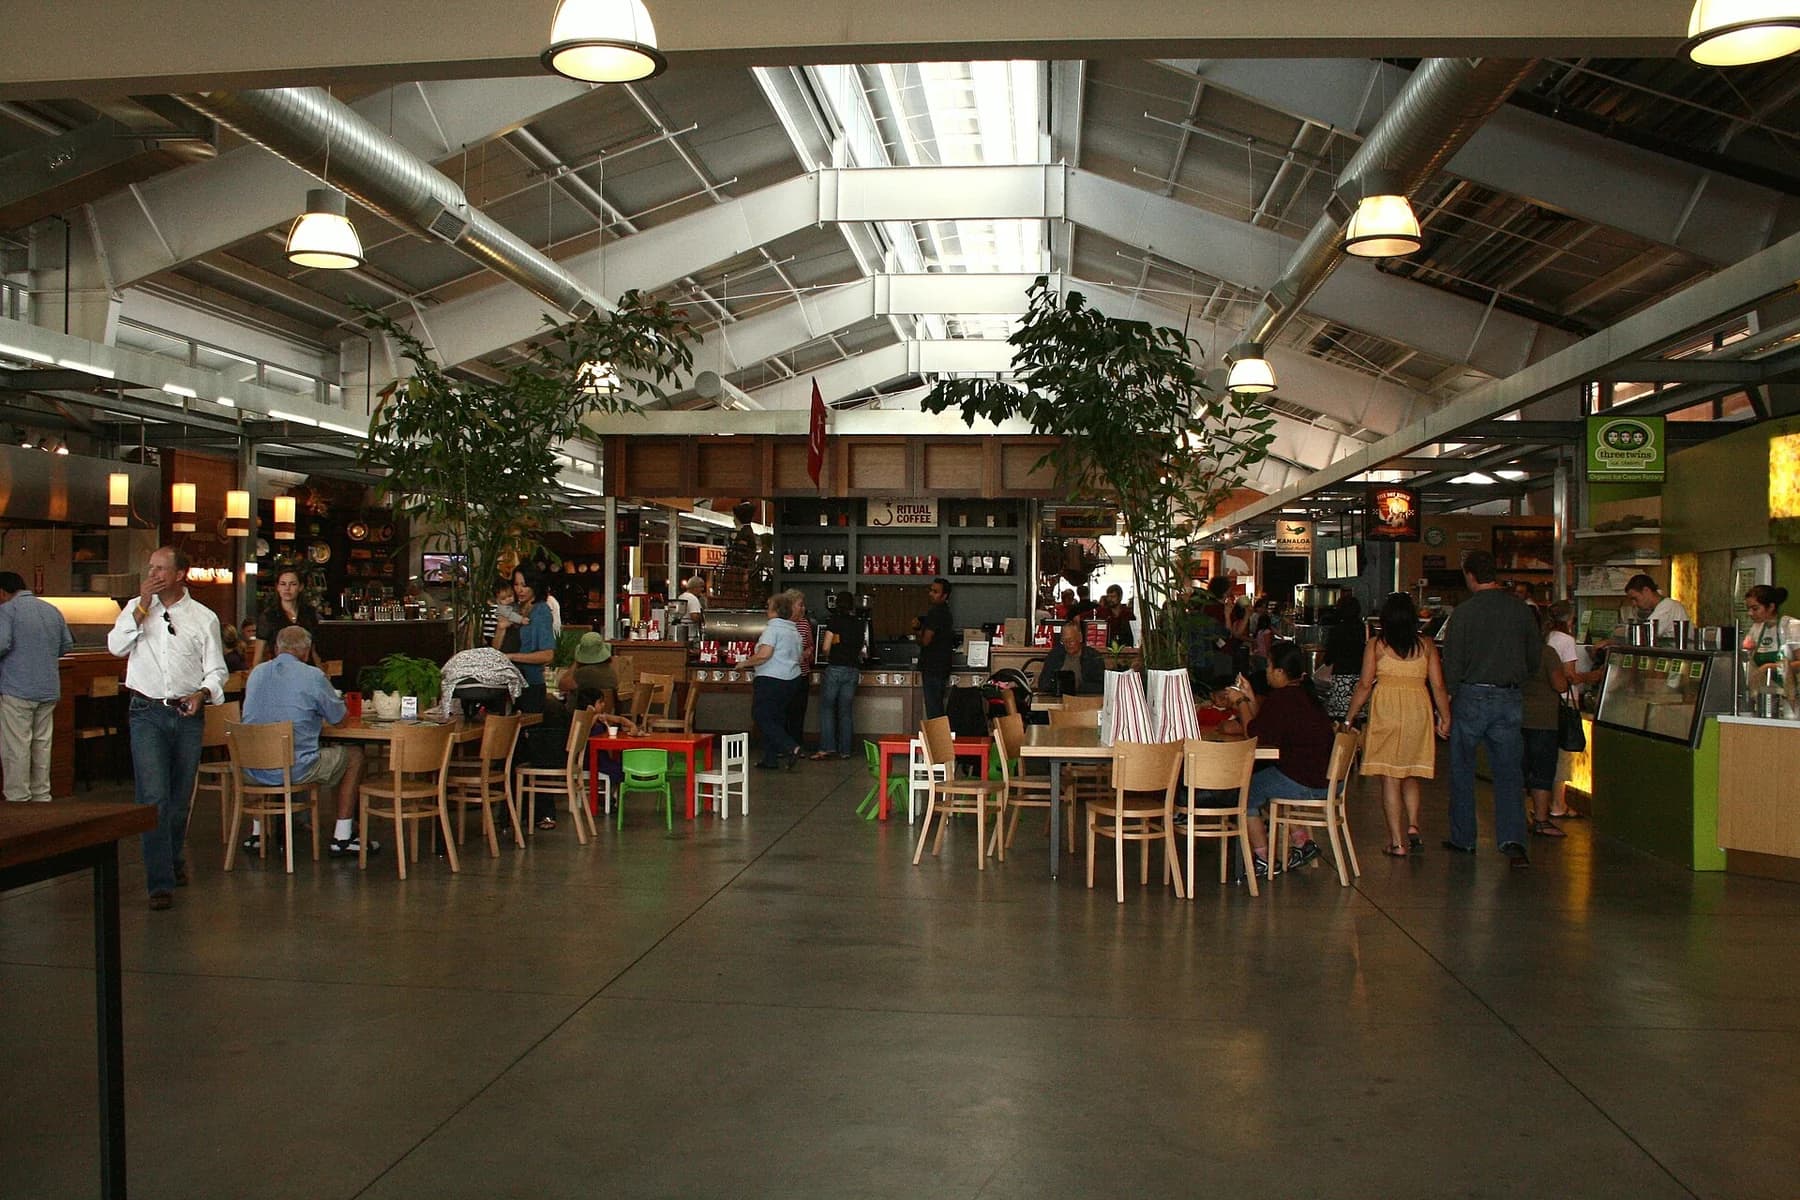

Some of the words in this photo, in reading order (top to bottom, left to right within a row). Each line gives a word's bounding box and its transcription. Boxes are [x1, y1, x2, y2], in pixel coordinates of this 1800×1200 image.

[1600, 450, 1625, 459] three
[1626, 449, 1652, 459] twins
[896, 505, 931, 514] RITUAL
[896, 514, 931, 524] COFFEE
